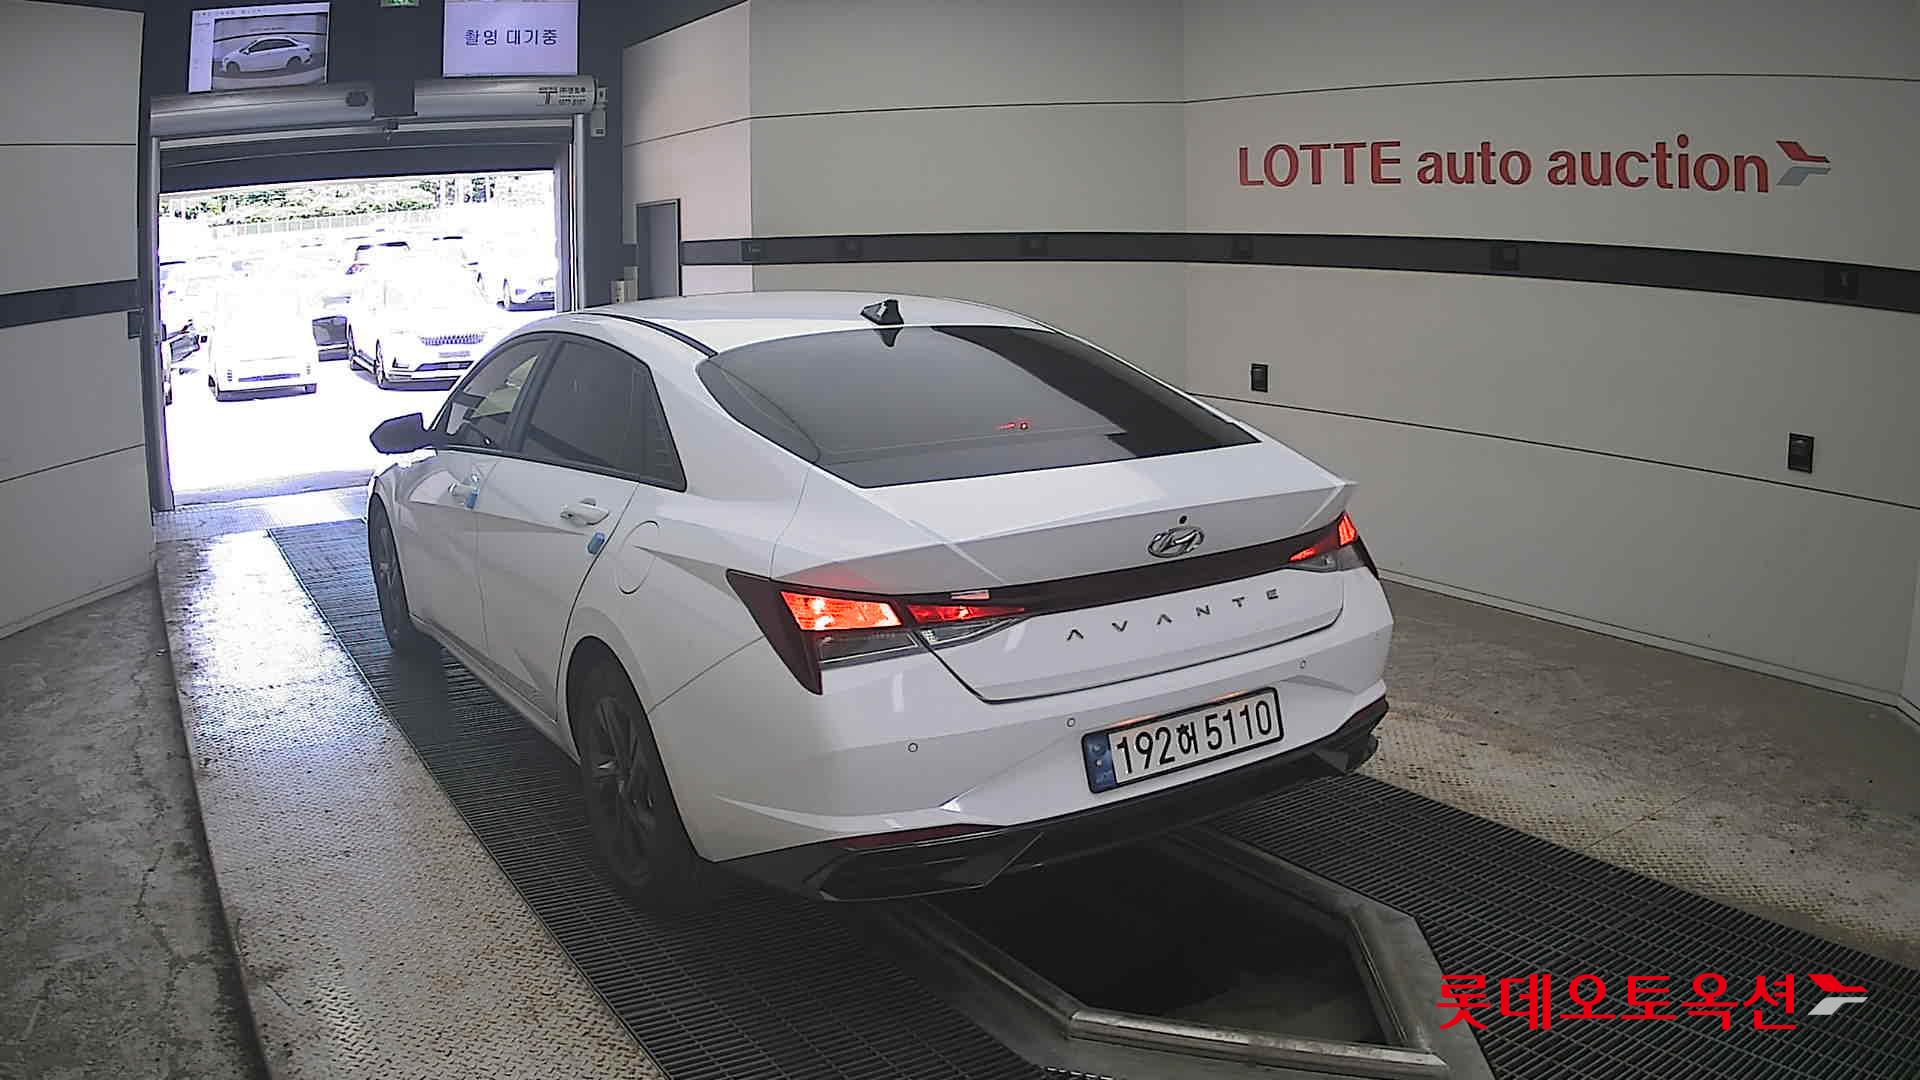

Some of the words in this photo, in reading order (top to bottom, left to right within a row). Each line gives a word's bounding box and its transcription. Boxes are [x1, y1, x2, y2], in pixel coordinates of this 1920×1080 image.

[506, 29, 558, 46] 대기중
[1239, 140, 1401, 187] LOTTE
[1416, 141, 1532, 186] auto
[1547, 134, 1769, 193] auction
[1066, 588, 1279, 641] AVANTE
